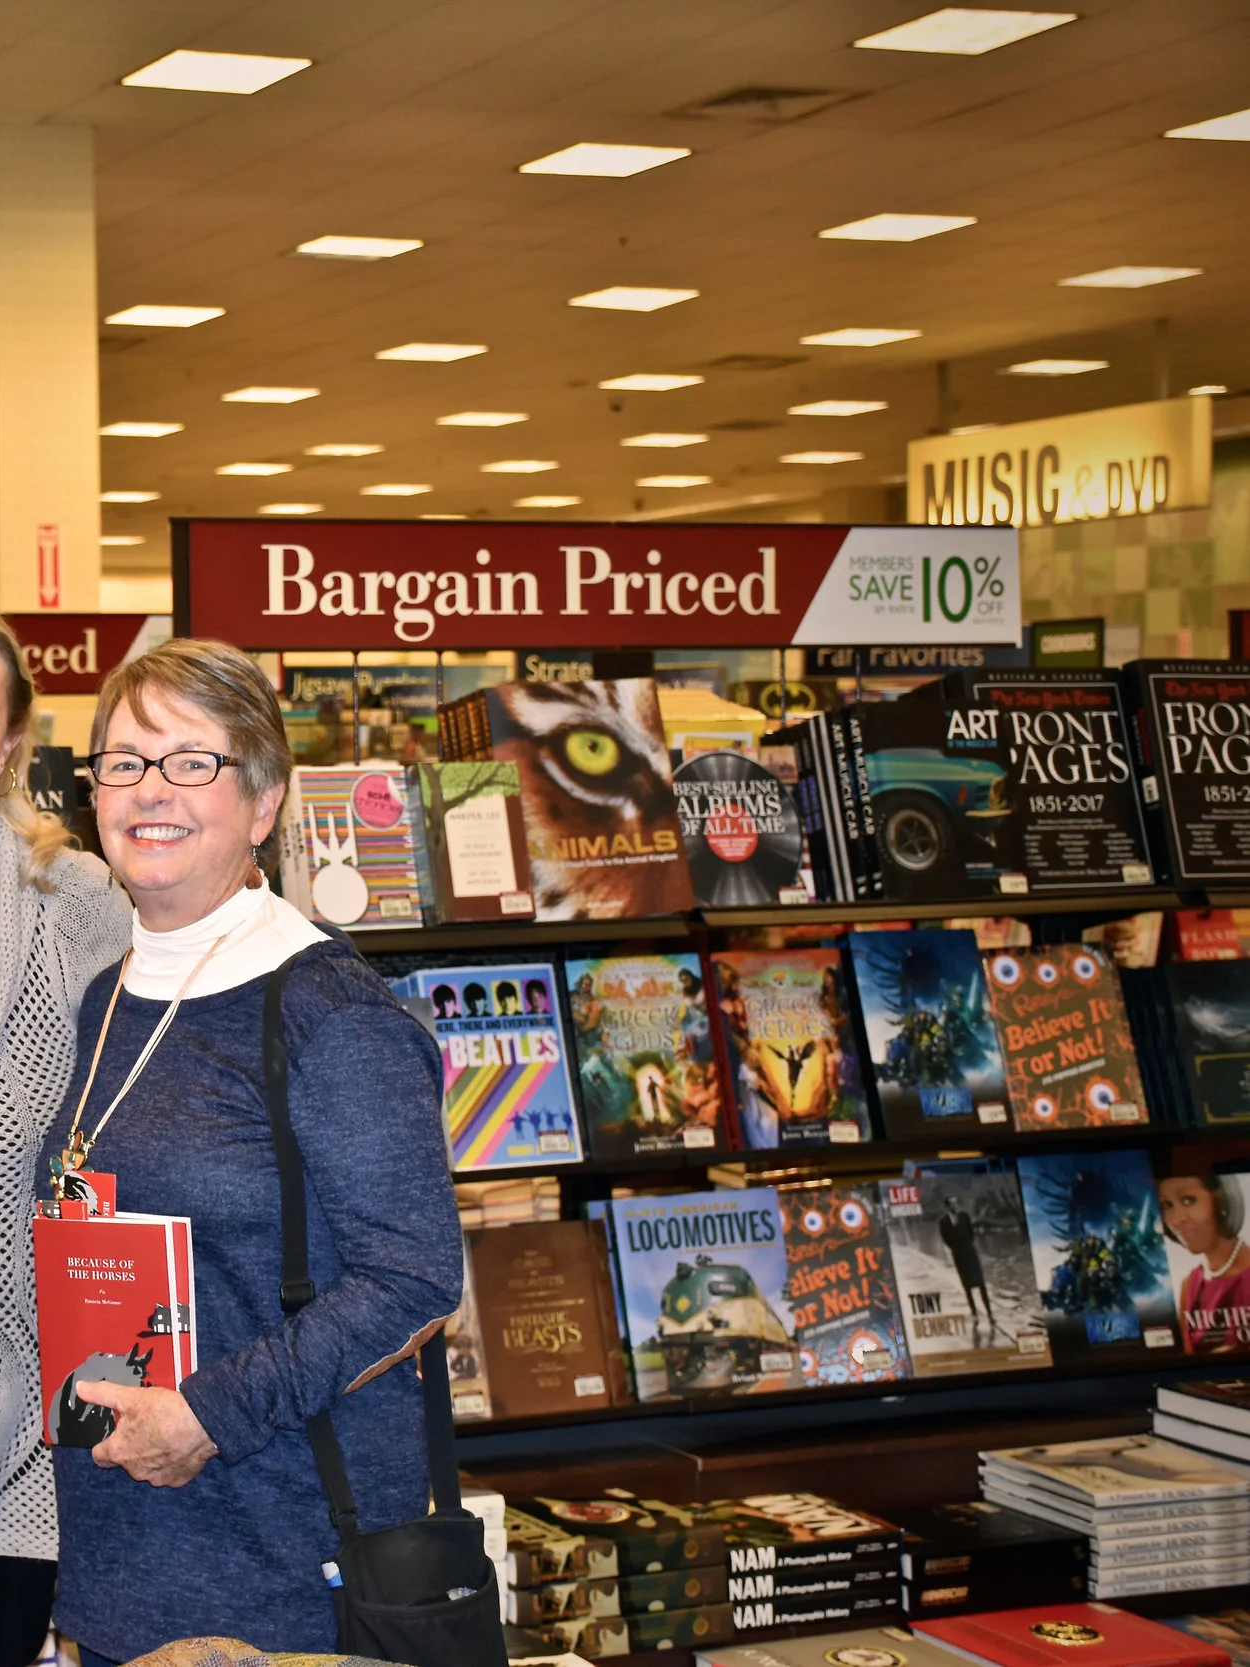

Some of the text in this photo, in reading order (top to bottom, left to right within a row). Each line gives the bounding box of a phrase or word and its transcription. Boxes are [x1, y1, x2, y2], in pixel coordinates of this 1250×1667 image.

[924, 445, 1059, 527] MUSIC
[1108, 455, 1170, 513] DVD
[849, 556, 914, 571] MEMBERS
[260, 543, 782, 643] Bargain Priced
[849, 575, 914, 601] SAVE
[977, 601, 1005, 616] OFF
[869, 647, 986, 668] Favorites
[946, 708, 999, 740] ART
[1009, 710, 1119, 746] RONT
[1009, 742, 1131, 785] AGES
[1167, 734, 1250, 775] PAG
[672, 779, 779, 797] BEST-SELLING
[831, 723, 846, 749] ART
[845, 809, 860, 840] CAR
[849, 717, 863, 744] ART
[861, 804, 876, 836] CAR
[677, 793, 783, 819] ALBUMS
[1029, 794, 1105, 814] 1851-2017
[679, 815, 786, 836] OF ALL TIME
[526, 829, 679, 860] ANIMALS
[602, 1004, 677, 1032] GREEK
[747, 999, 821, 1019] GREEK
[749, 1015, 836, 1041] HEROES
[1005, 997, 1111, 1053] Believe It
[447, 1028, 561, 1069] BEATLES
[610, 1029, 675, 1051] GODS
[1029, 1051, 1055, 1077] or
[1056, 1028, 1106, 1069] Not!
[888, 1185, 920, 1204] LIFE
[625, 1202, 739, 1219] NORTH AMERICAN
[626, 1209, 776, 1253] LOCOMOTIVES
[67, 1257, 135, 1270] BECAUSE OF
[854, 1246, 881, 1275] It
[67, 1269, 136, 1282] THE HORSES
[794, 1305, 818, 1328] or
[821, 1277, 871, 1321] Not!
[908, 1293, 942, 1315] TONY
[912, 1314, 967, 1340] BENNETT
[1184, 1306, 1250, 1330] MICHE
[503, 1323, 583, 1353] BEASTS
[730, 1545, 776, 1573] NAM
[728, 1574, 774, 1601] NAM
[733, 1602, 774, 1630] NAM
